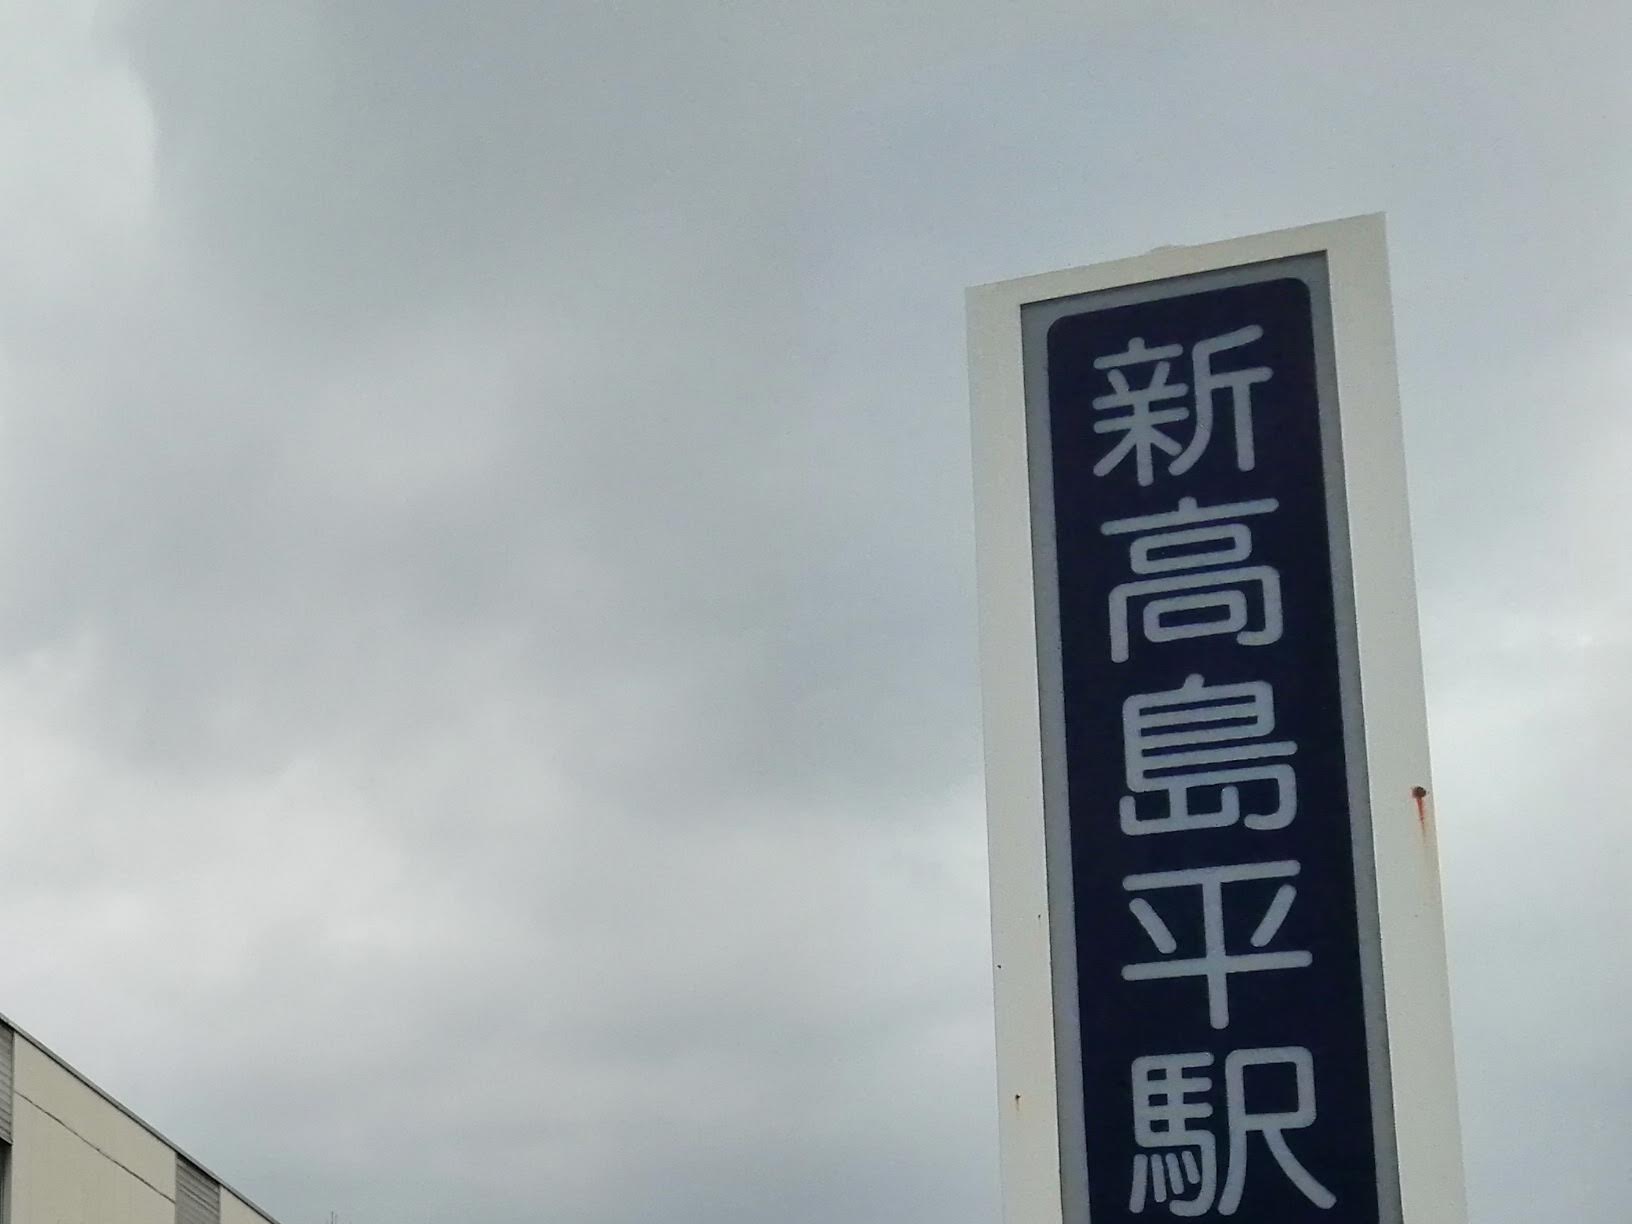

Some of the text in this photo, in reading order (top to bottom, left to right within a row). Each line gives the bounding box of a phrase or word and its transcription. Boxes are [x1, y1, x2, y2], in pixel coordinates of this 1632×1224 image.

[1092, 323, 1338, 1218] 新高島平駅
